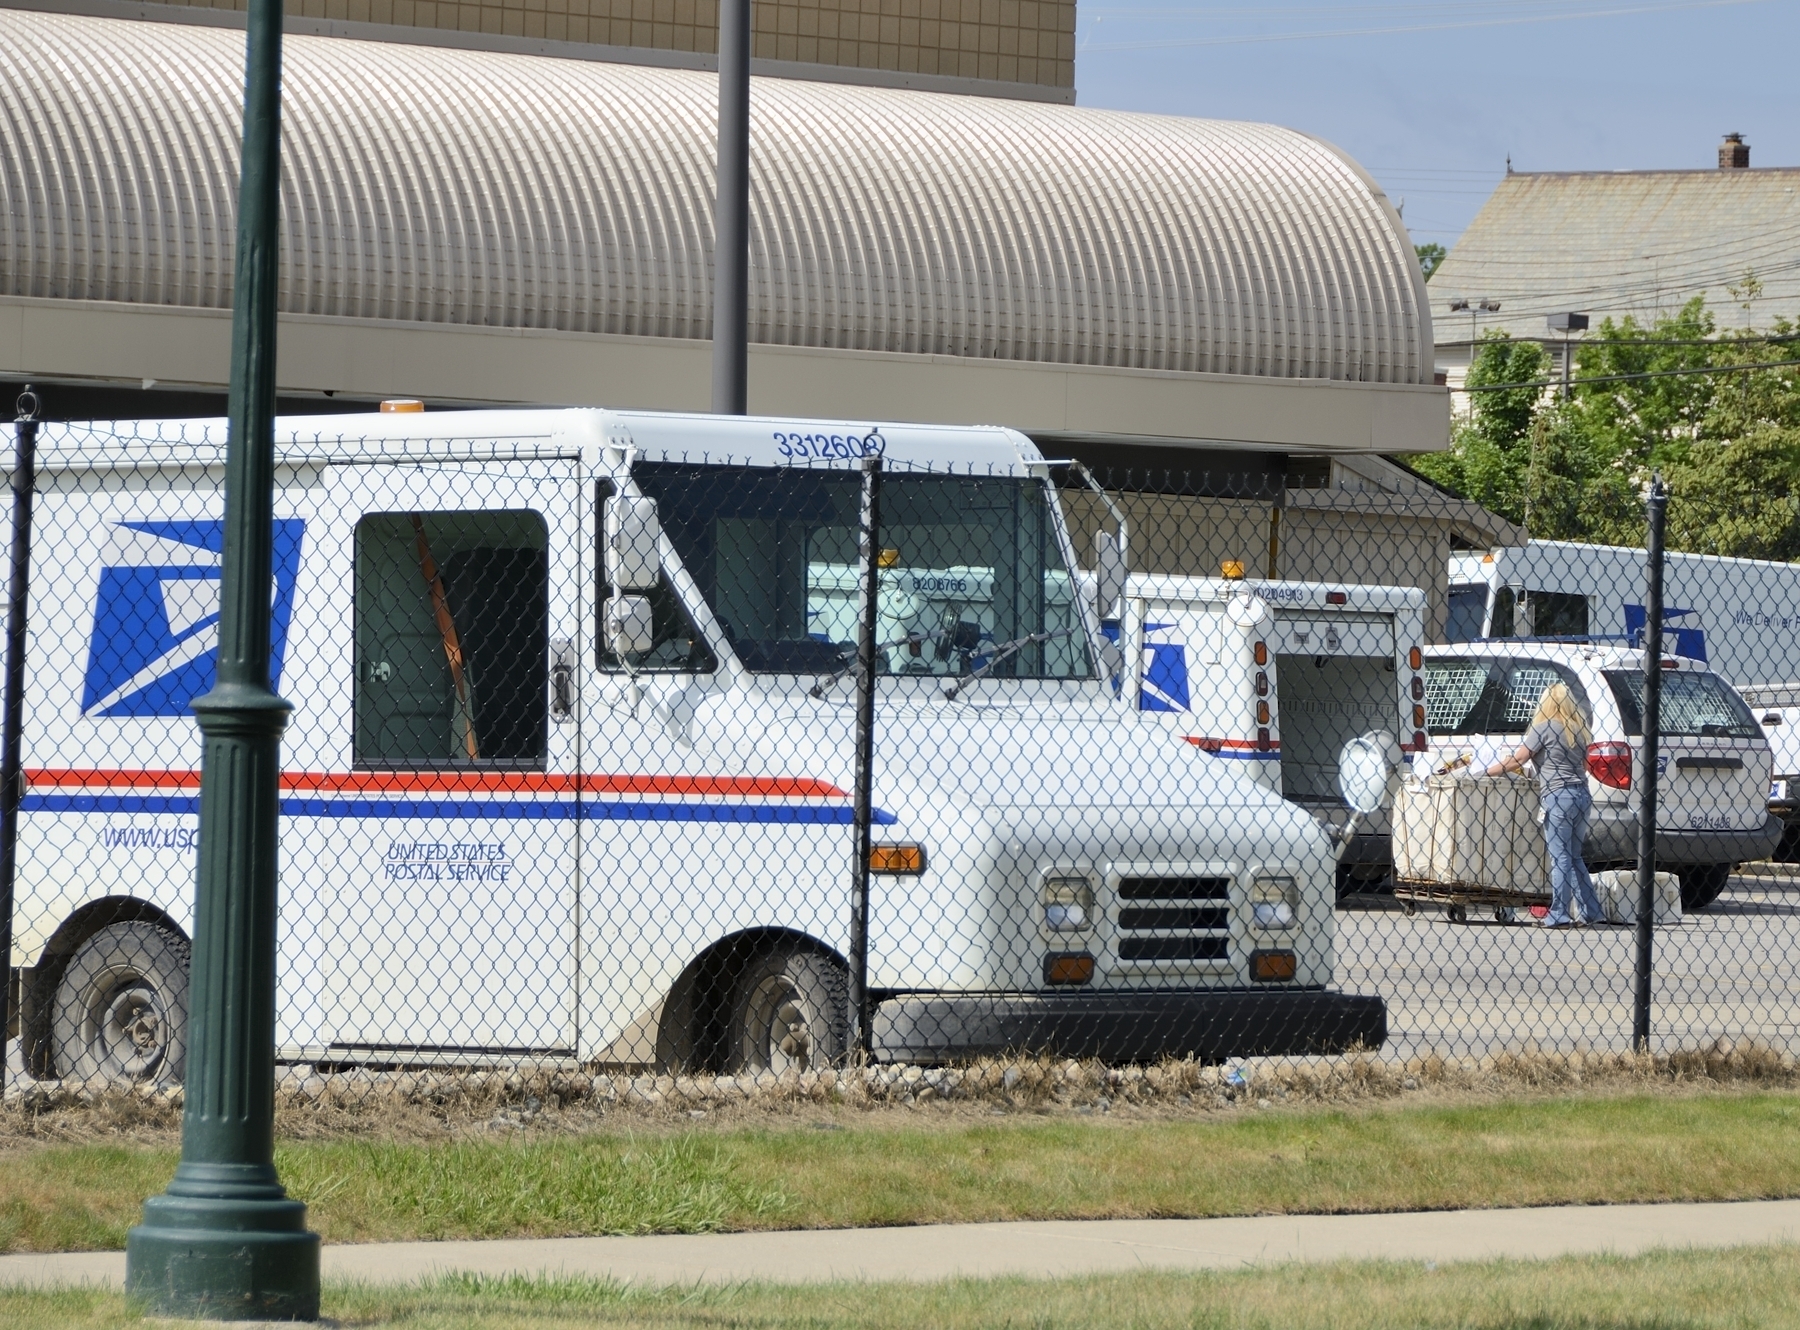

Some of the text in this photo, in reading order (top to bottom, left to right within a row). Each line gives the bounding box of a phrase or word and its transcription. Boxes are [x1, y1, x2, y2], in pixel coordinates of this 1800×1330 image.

[1735, 610, 1753, 626] We
[1754, 611, 1793, 629] Deliver
[387, 843, 505, 861] UNITED STATES
[384, 863, 511, 881] POSTAL SERVICE
